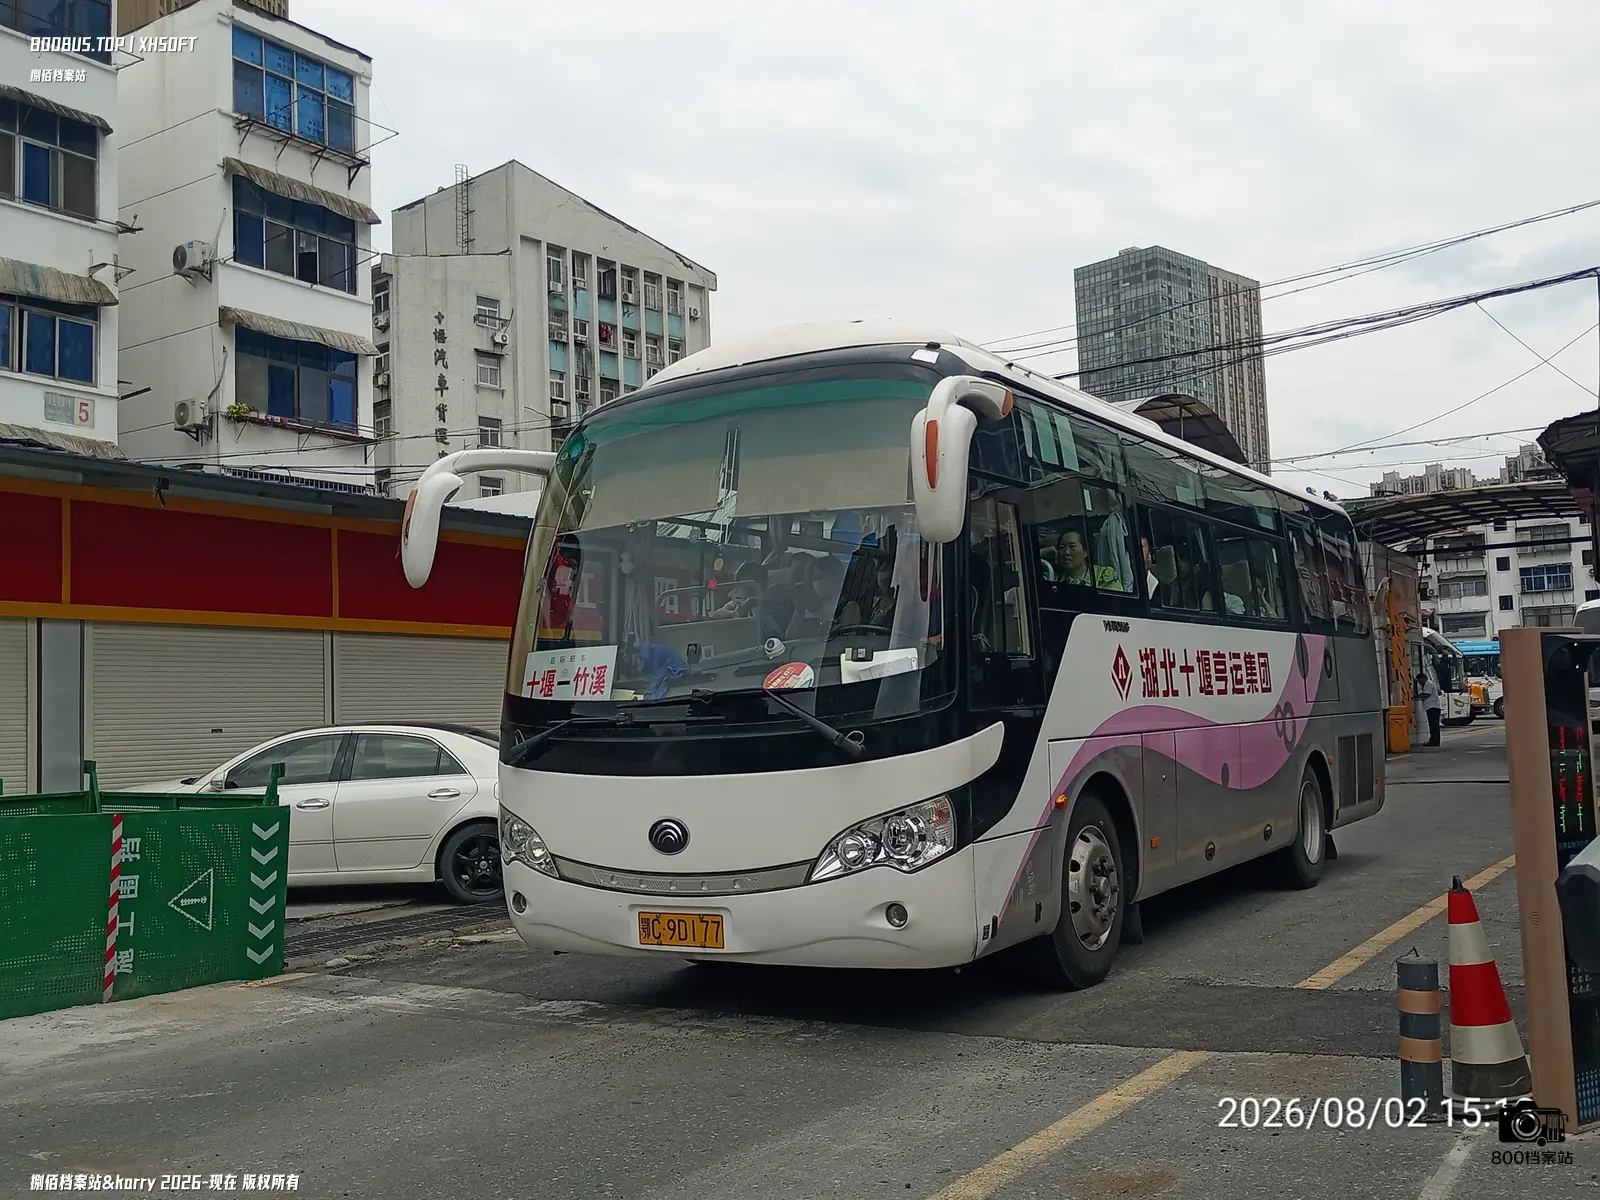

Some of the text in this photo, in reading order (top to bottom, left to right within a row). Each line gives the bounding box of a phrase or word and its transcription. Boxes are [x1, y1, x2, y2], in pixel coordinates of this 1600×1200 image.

[79, 401, 89, 423] 5
[1138, 647, 1273, 698] 湖北十堰亨运集团
